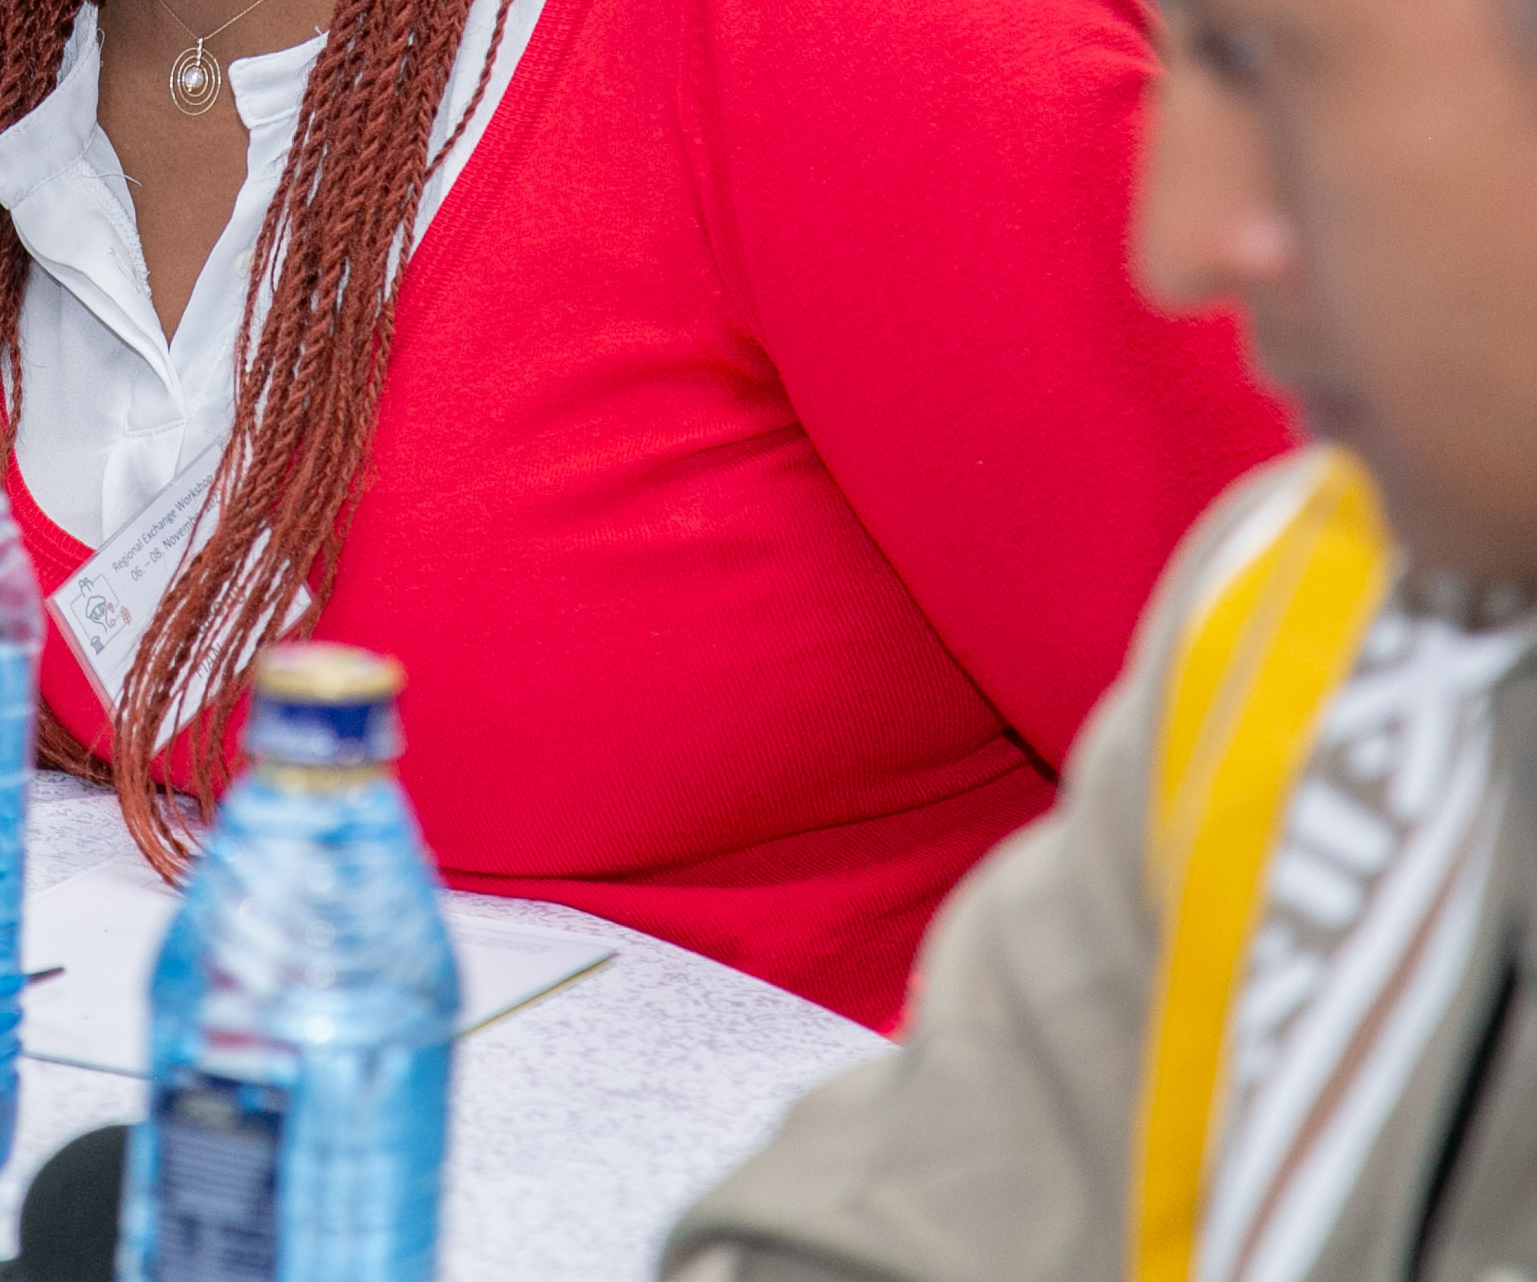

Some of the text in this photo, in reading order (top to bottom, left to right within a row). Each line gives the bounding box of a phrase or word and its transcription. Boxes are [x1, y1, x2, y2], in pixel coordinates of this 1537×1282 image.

[111, 537, 144, 573] Regional
[141, 508, 178, 545] Exchange
[130, 565, 146, 582] 06.
[149, 547, 165, 564] 08.
